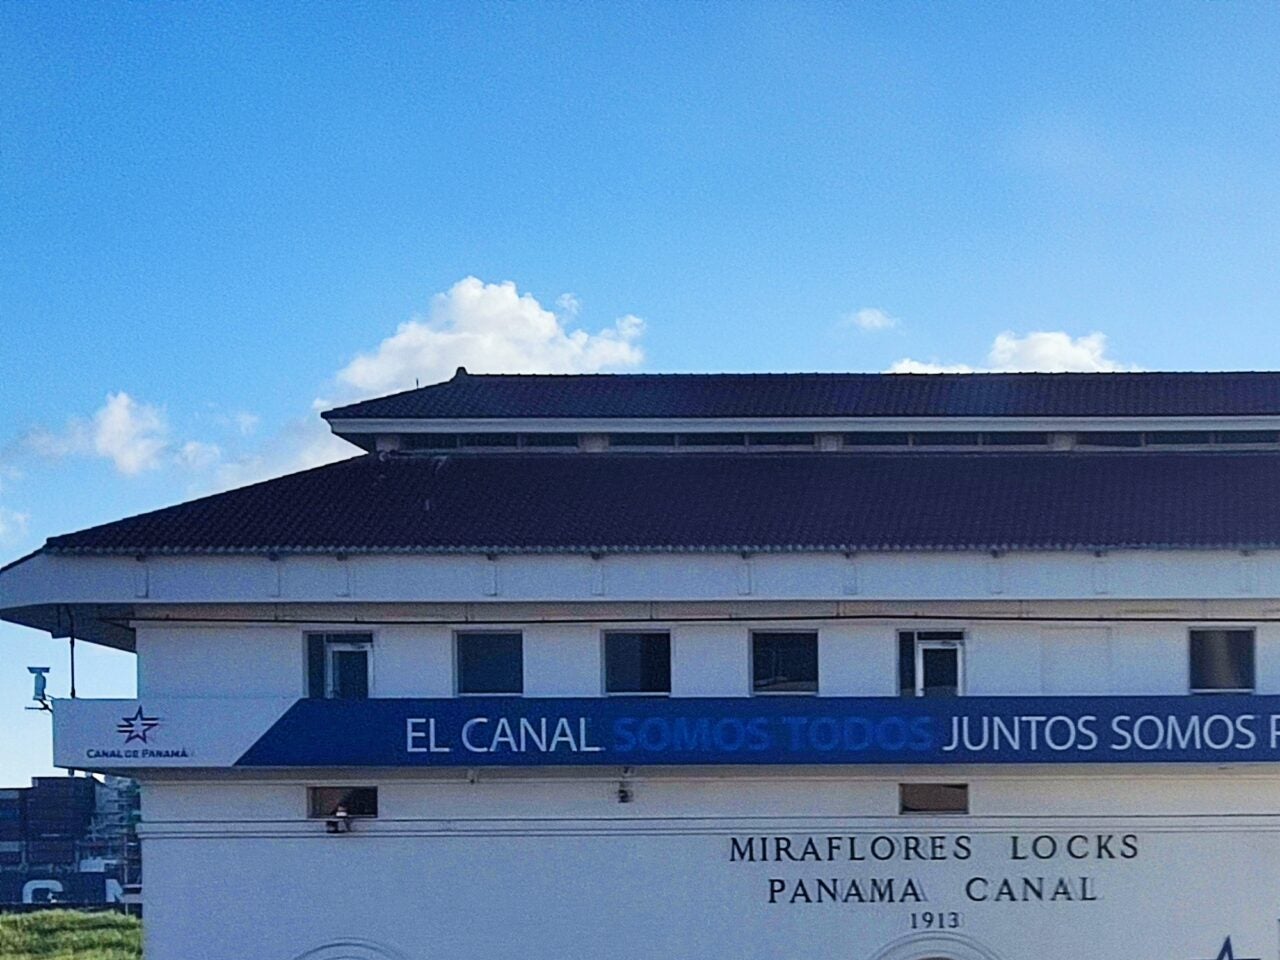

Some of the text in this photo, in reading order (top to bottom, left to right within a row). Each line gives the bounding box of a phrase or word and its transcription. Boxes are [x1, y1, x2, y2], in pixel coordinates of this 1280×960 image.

[406, 718, 450, 752] EL
[461, 717, 604, 752] CANAL
[612, 716, 772, 751] SOMOS
[781, 716, 935, 751] TODOS
[942, 715, 1098, 750] JUNTOS
[1111, 714, 1256, 750] SOMOS
[729, 833, 1139, 862] MIRAFLORES LOCKS
[767, 876, 1098, 903] PANAMA CANAL
[910, 911, 961, 930] 1913
